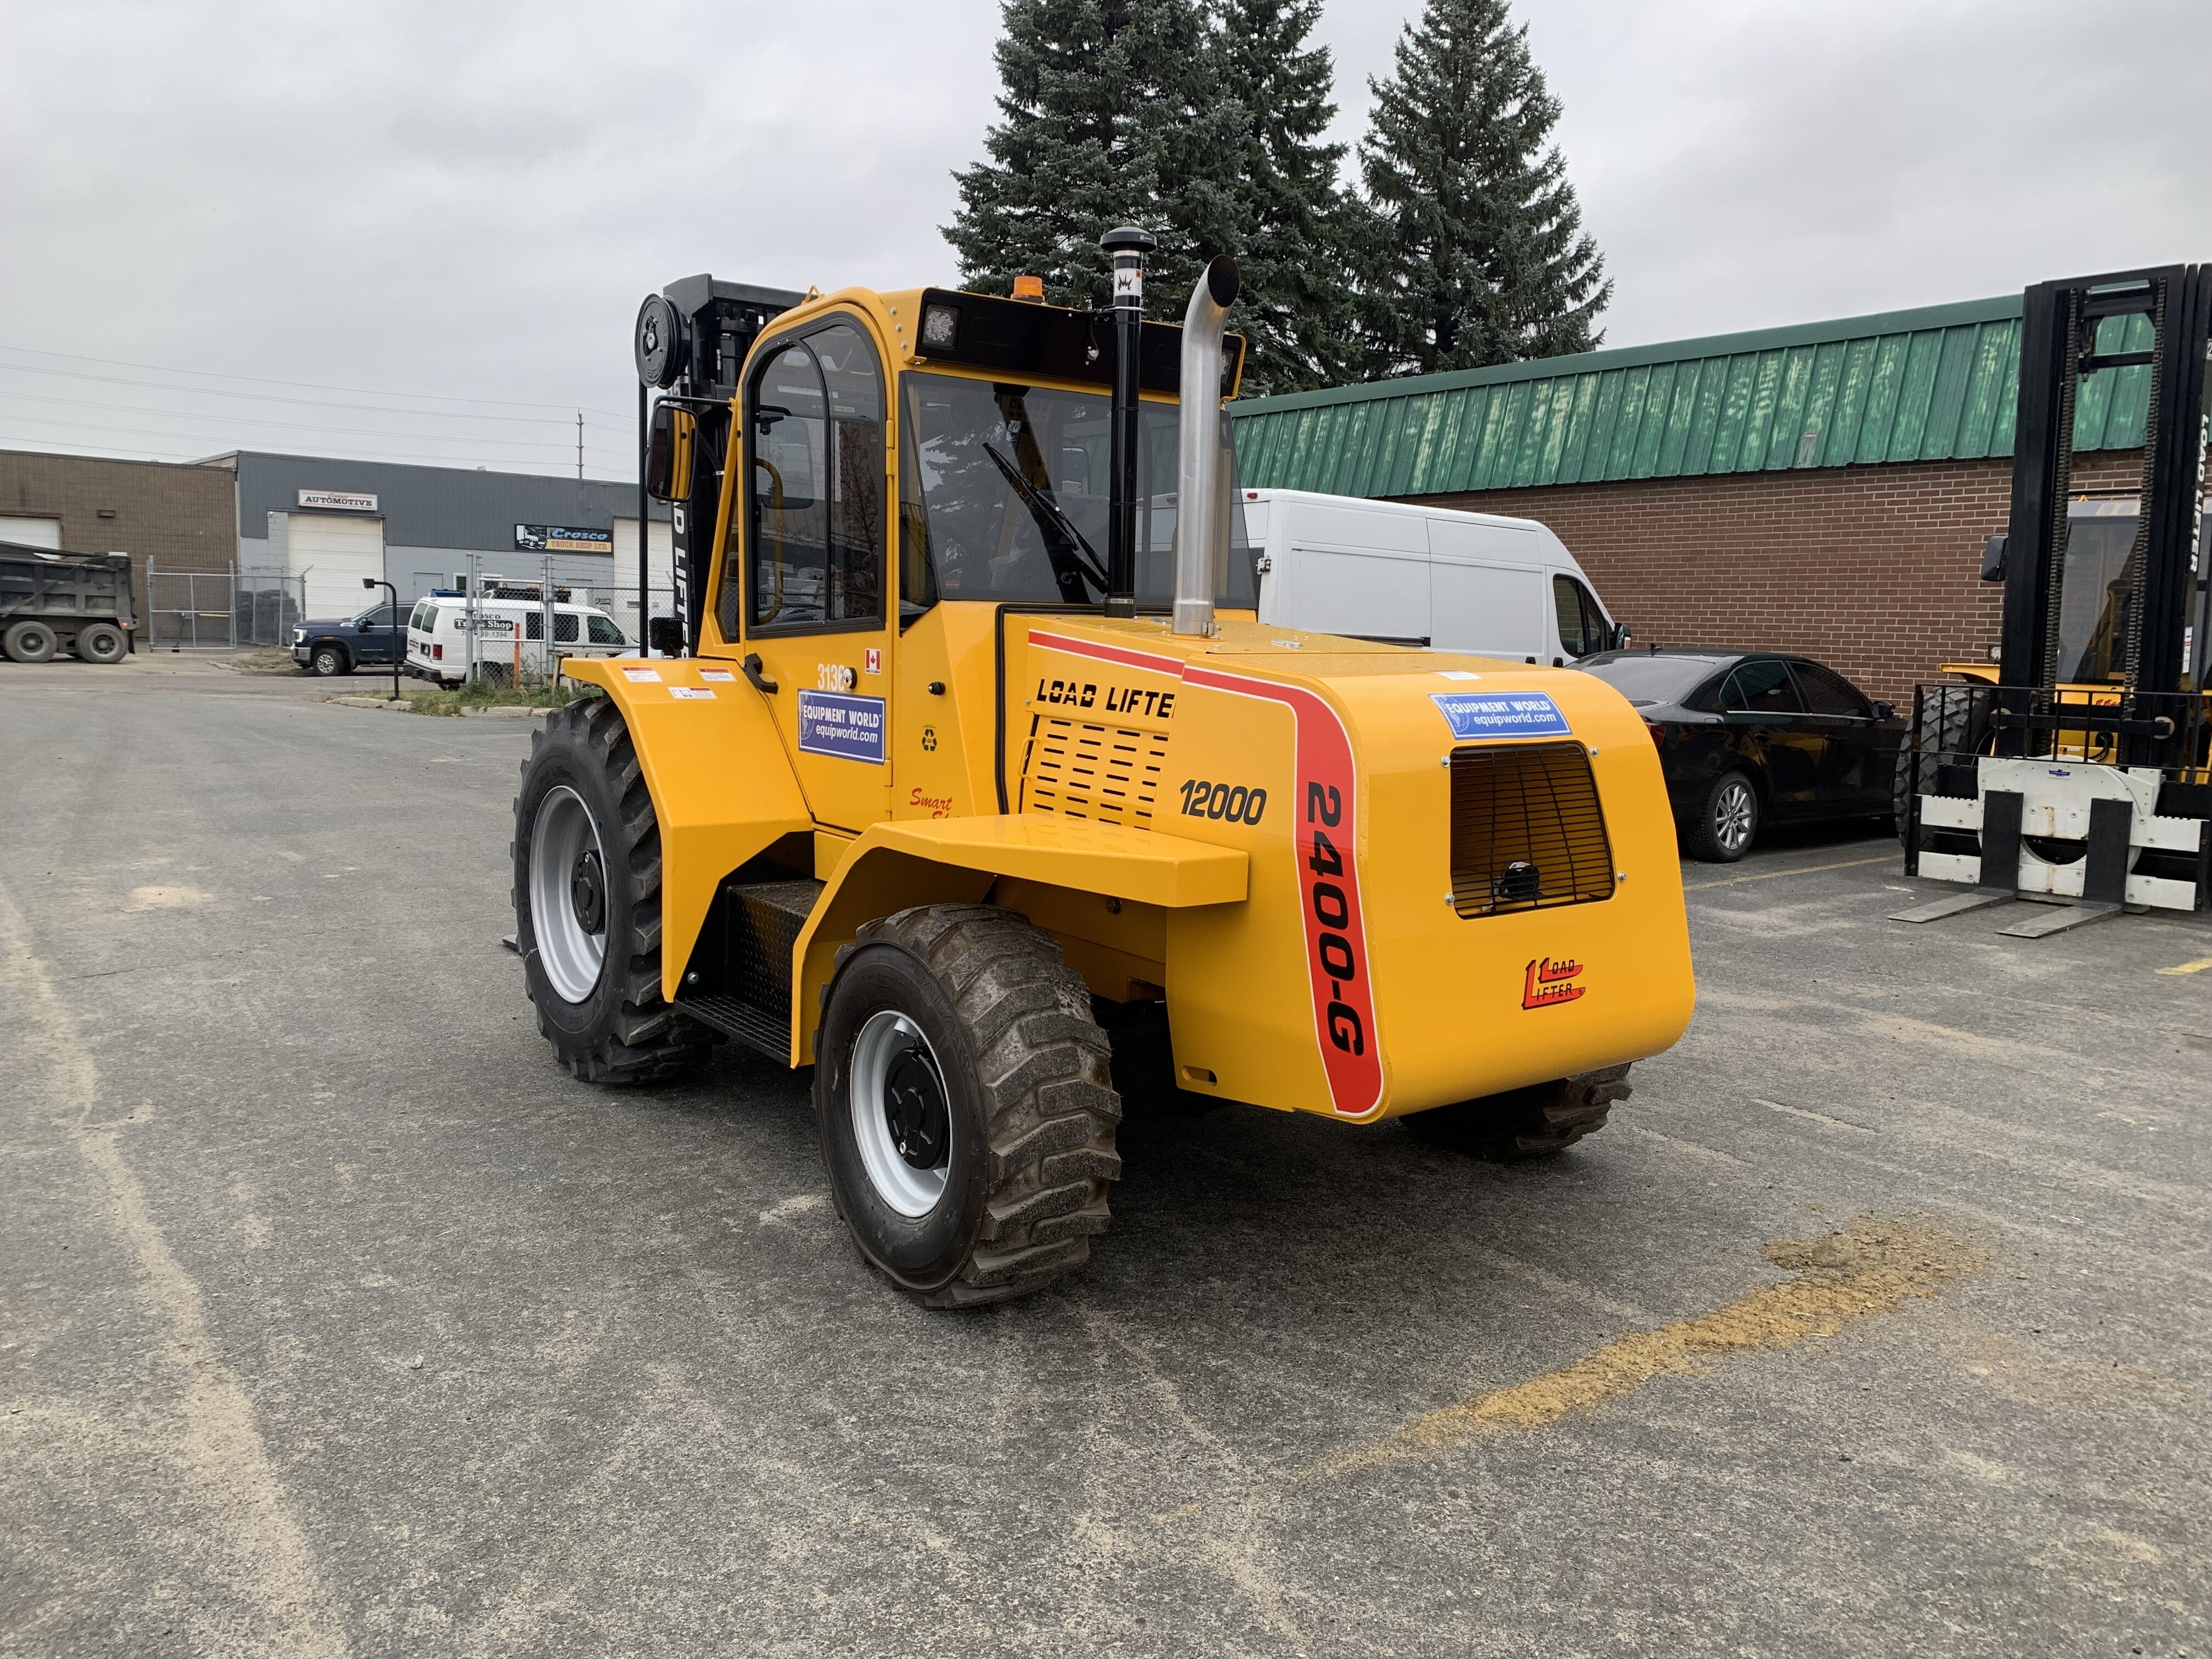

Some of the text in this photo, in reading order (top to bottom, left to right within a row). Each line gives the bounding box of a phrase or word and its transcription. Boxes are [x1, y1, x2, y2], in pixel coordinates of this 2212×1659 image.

[305, 496, 373, 506] AUTOMOTIVE
[2191, 414, 2209, 572] LOAD LIFTER
[551, 527, 608, 540] Crosco
[455, 619, 512, 630] Trk Shop
[1036, 679, 1178, 719] LOAD LIFTE
[1445, 702, 1510, 714] EQUIPMENT
[803, 704, 846, 724] EQUIPMENT
[1474, 713, 1557, 727] equipworld.com
[816, 723, 878, 743] equipworld.com
[909, 787, 953, 811] Smart
[1180, 779, 1267, 826] 12000
[1307, 781, 1364, 1057] 2400-G
[1538, 957, 1583, 984] LOAD
[1521, 959, 1585, 1011] LIFTER
